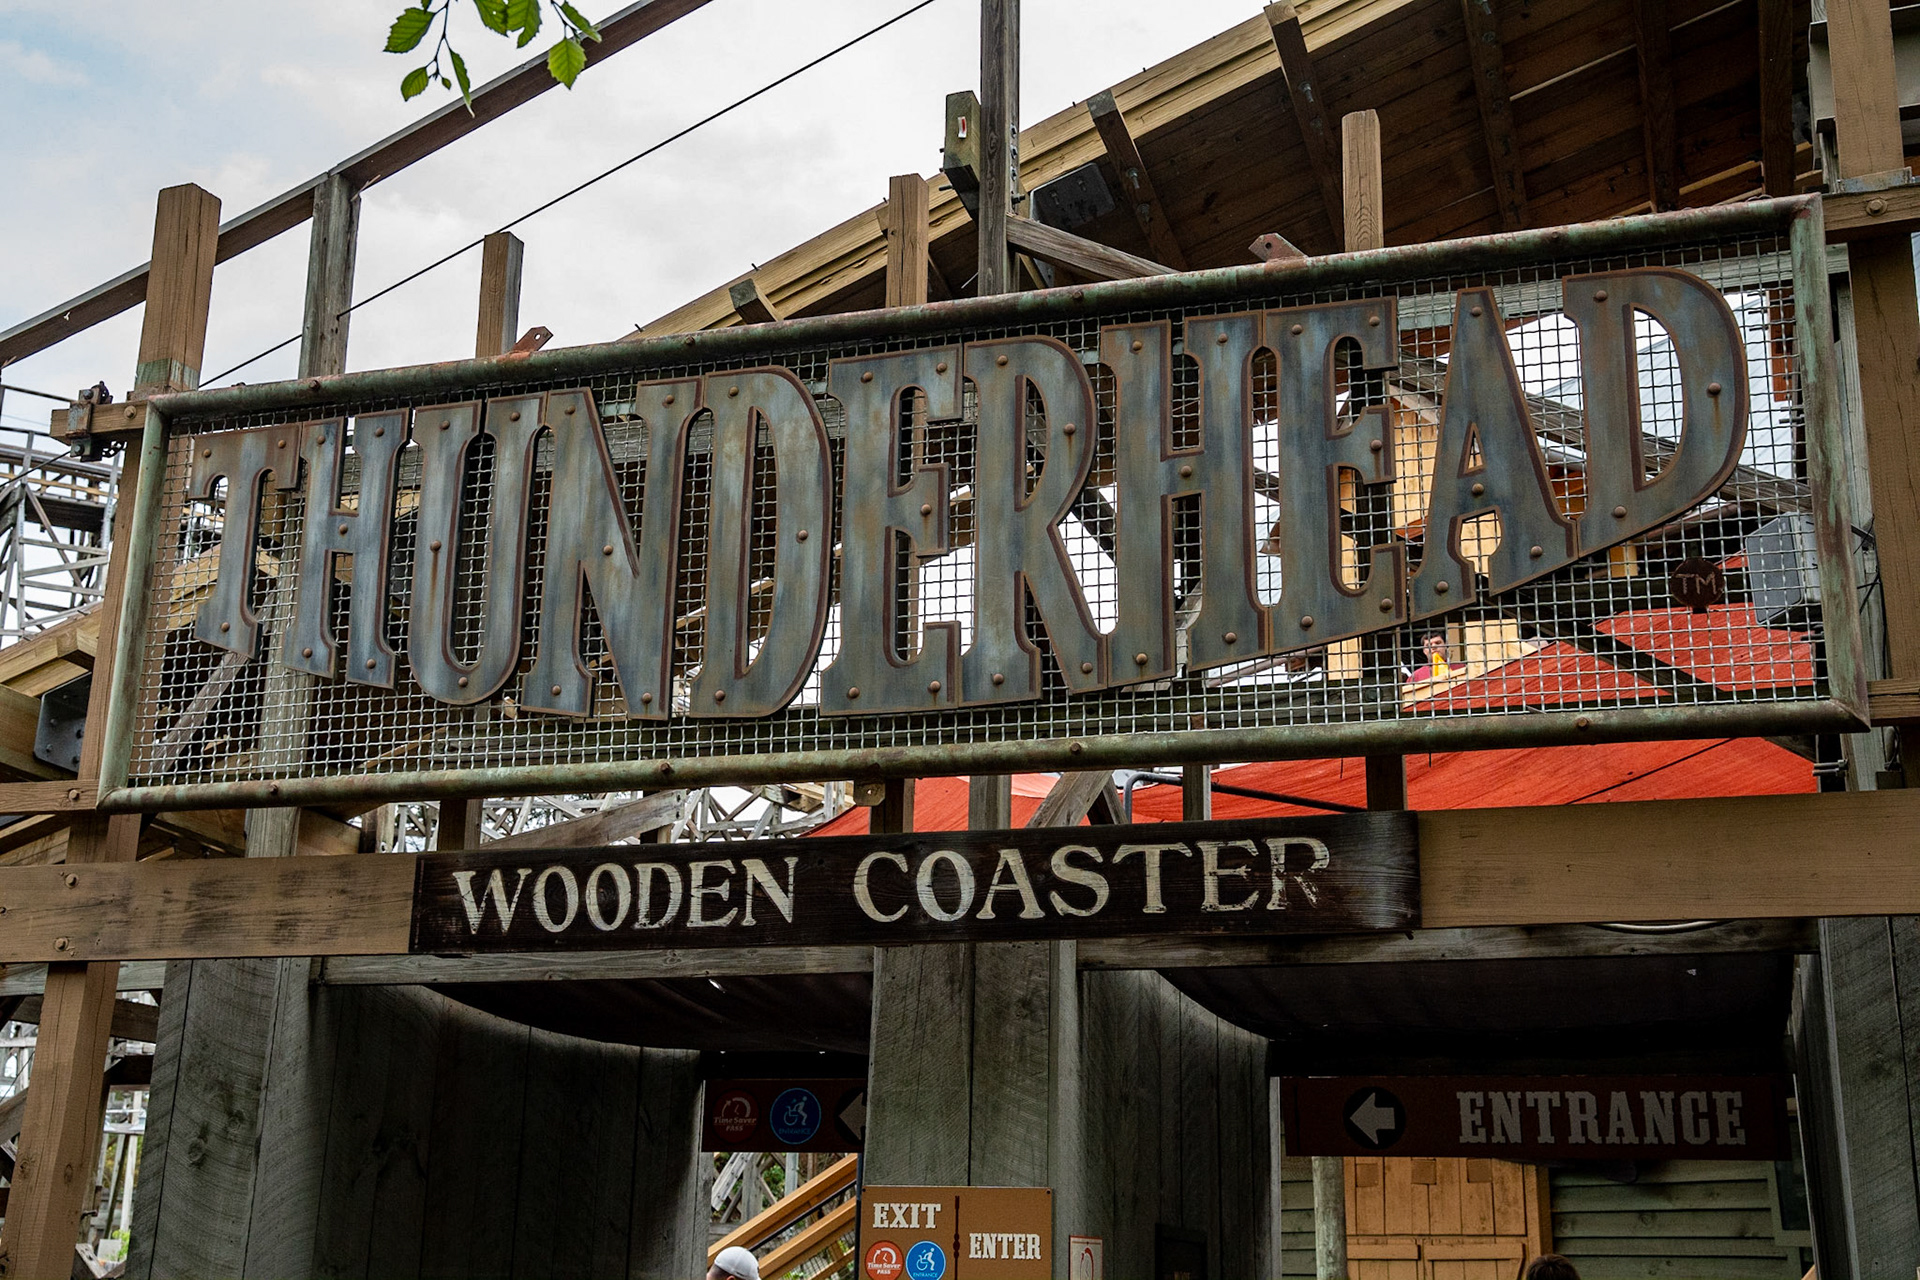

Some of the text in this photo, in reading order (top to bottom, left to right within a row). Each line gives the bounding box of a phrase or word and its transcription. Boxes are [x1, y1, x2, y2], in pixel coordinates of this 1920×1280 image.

[188, 266, 1749, 721] THUNDERHEAD
[1675, 571, 1718, 596] TM
[452, 836, 1331, 935] WOODEN COASTER
[713, 1116, 733, 1124] Time
[1456, 1091, 1748, 1146] ENTRANCE
[872, 1202, 942, 1230] EXIT
[968, 1233, 1042, 1260] ENTER
